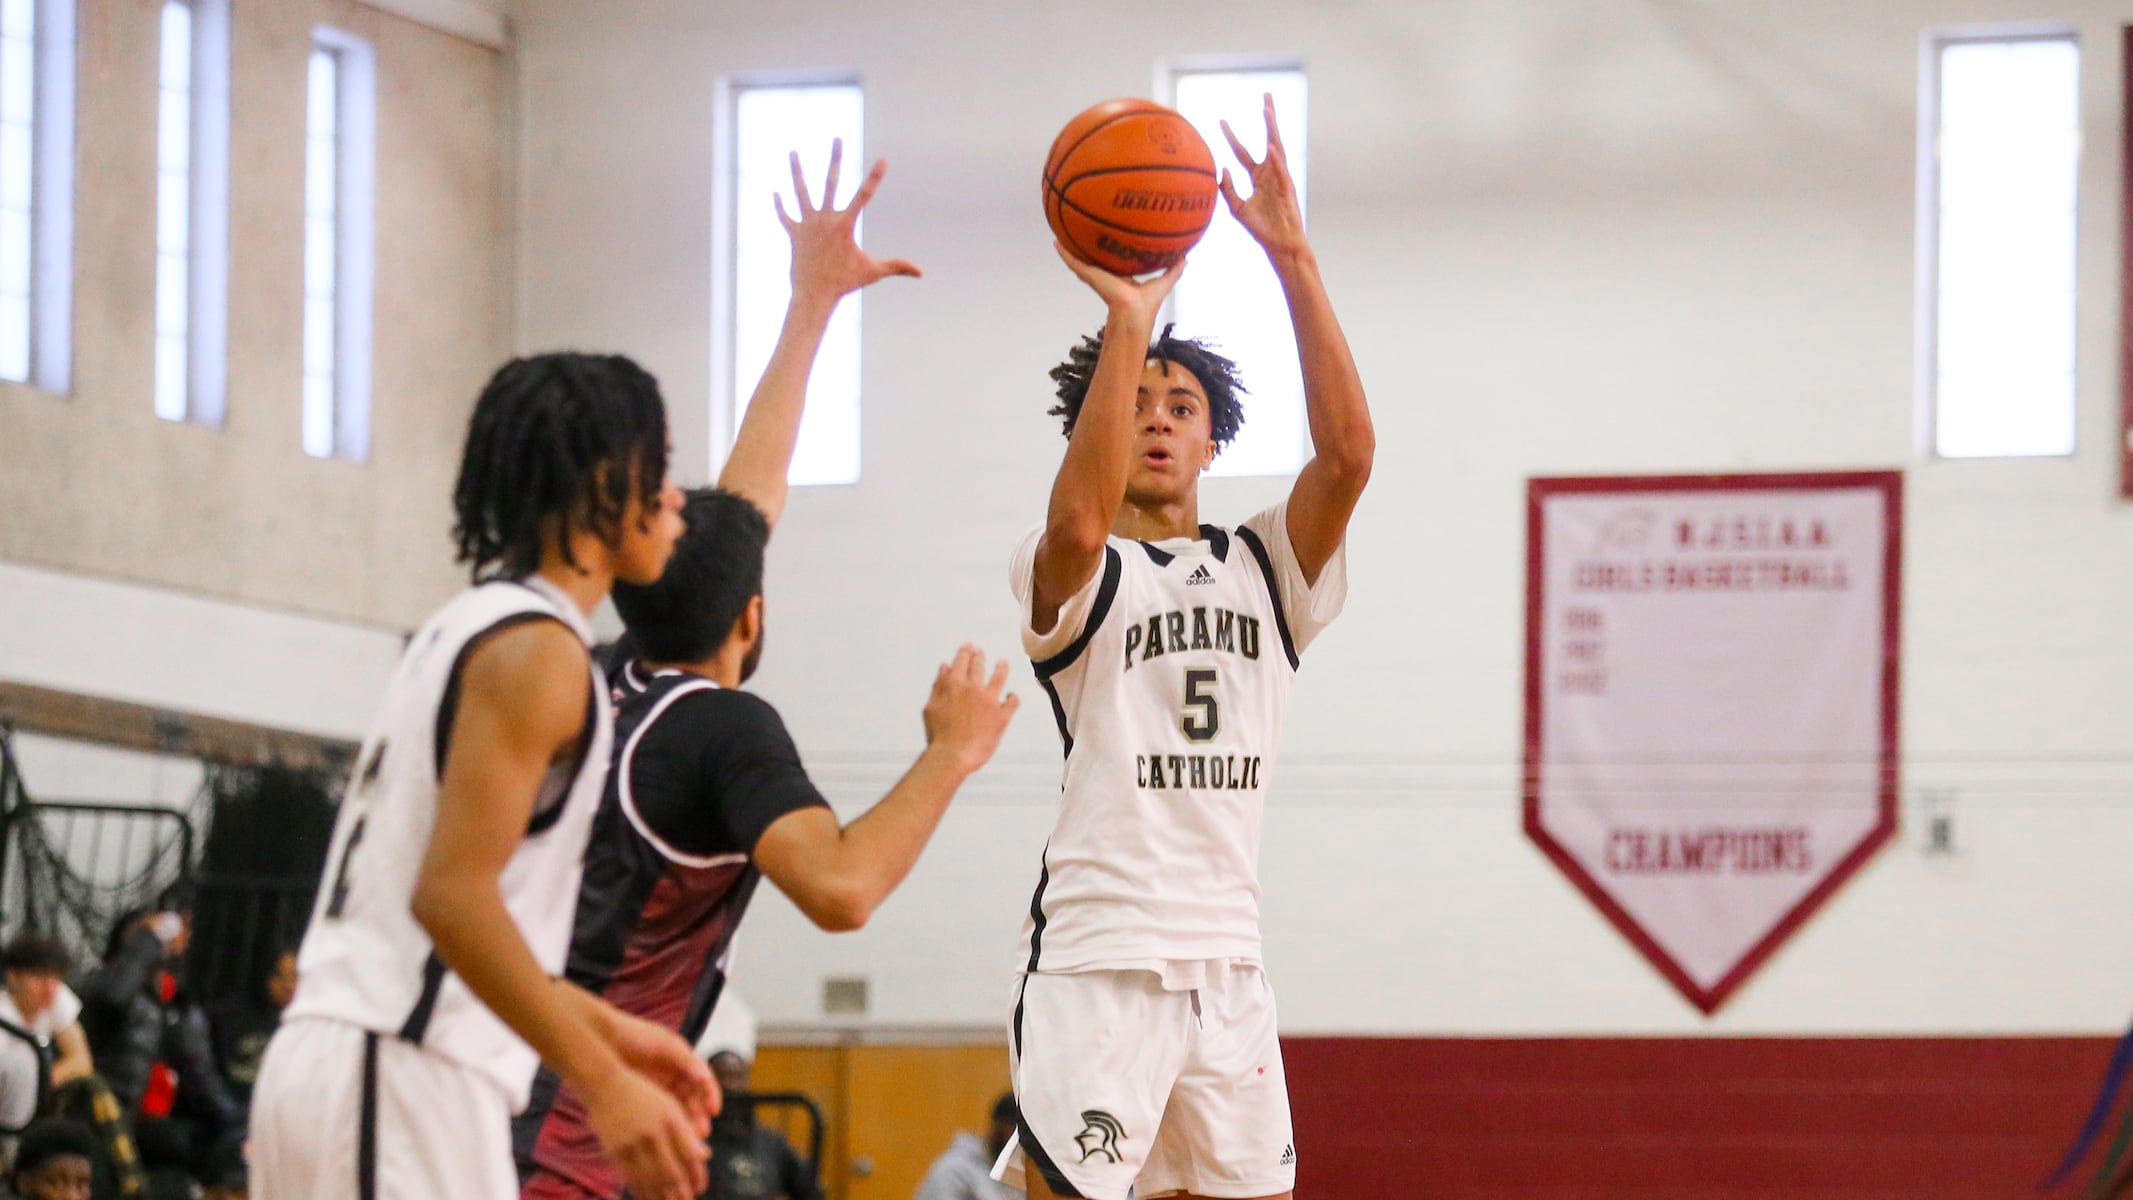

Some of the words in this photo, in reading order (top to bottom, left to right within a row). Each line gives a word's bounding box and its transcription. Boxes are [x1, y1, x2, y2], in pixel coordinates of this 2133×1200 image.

[1186, 576, 1215, 586] adidas
[1573, 559, 1652, 591] GIRLS
[1661, 555, 1852, 591] BASKETBALL
[1180, 667, 1222, 744] 5
[1137, 754, 1261, 790] CATHOLIC
[1606, 827, 1812, 874] CHAMPIONS
